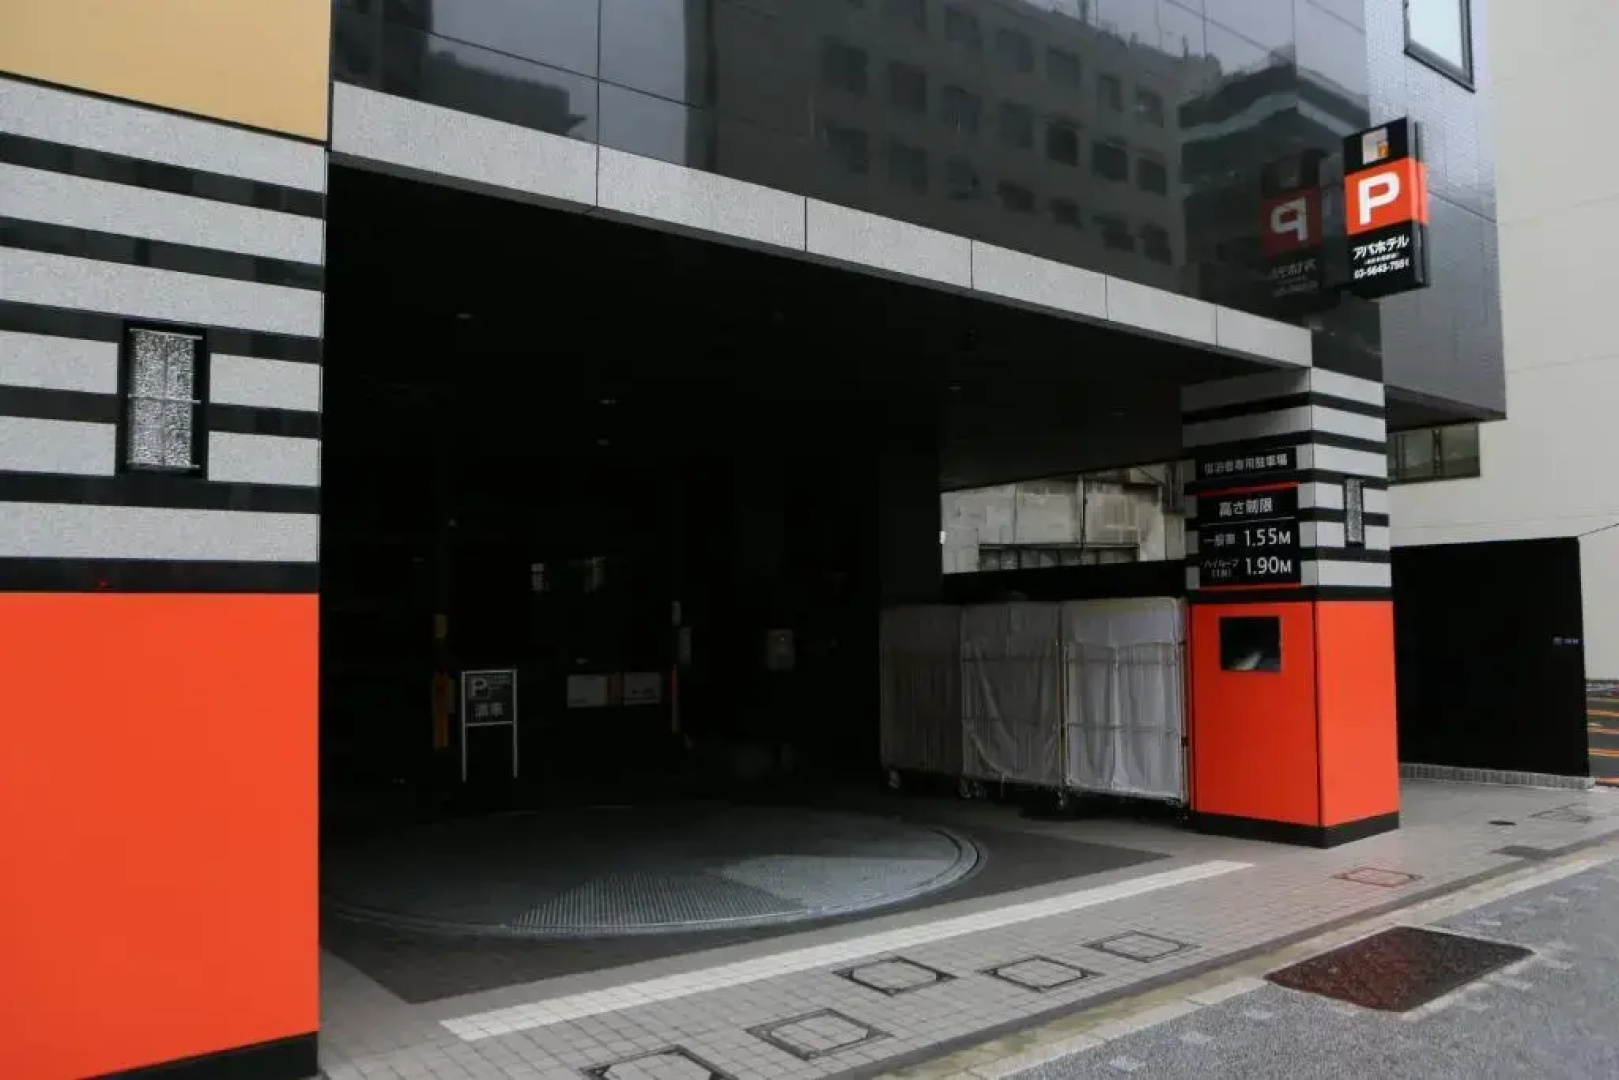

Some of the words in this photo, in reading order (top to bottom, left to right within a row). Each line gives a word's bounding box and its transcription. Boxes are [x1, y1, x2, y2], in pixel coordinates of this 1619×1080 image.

[1358, 171, 1400, 225] P
[1353, 234, 1410, 260] アパホテル
[1218, 497, 1274, 518] 高さ制限
[1244, 527, 1291, 547] 1.55M
[1245, 556, 1292, 576] 1.90M
